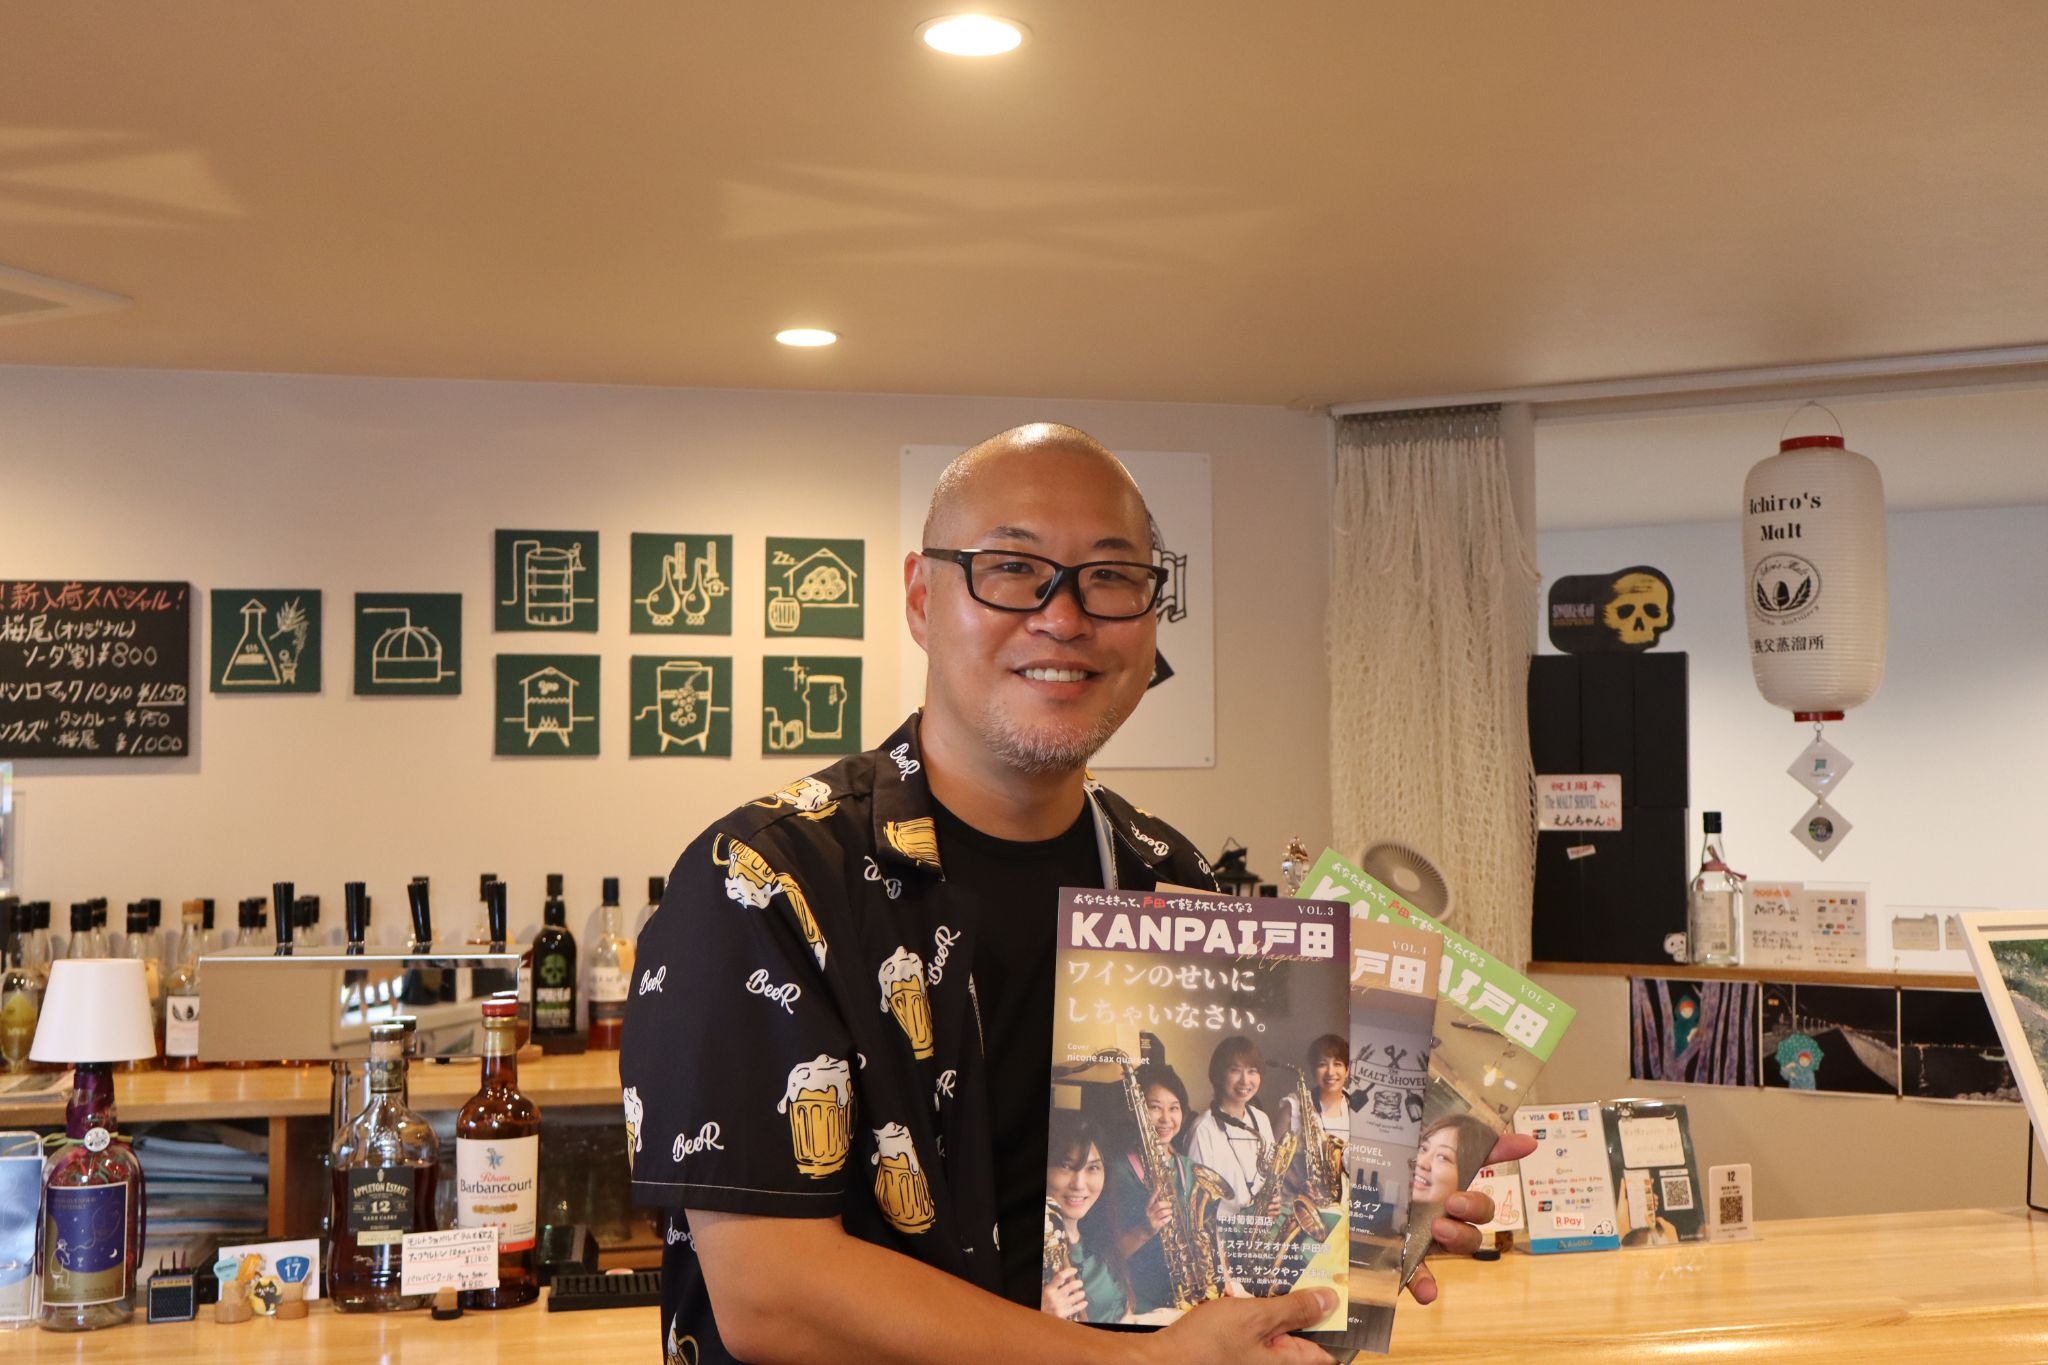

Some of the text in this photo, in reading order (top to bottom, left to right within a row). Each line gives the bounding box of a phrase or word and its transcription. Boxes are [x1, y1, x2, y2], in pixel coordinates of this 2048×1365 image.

[1750, 492, 1821, 514] Ichiro's
[1760, 523, 1802, 541] Malt
[98, 641, 158, 668] ¥800
[1073, 893, 1253, 913] あなたもきっと、戸田で乾杯したくなる
[1298, 905, 1334, 916] VOL.3
[1071, 911, 1334, 959] KANPAI戸田
[639, 965, 667, 996] BeeR
[1068, 960, 1256, 992] ワインのせいに
[745, 968, 802, 1015] BeeR
[1068, 997, 1266, 1033] しちゃいなさい。
[1098, 1055, 1115, 1064] sax
[1358, 1066, 1427, 1087] MALT SHOVEL
[672, 1121, 725, 1162] BeeR
[460, 1178, 532, 1194] Barbancourt
[1727, 1171, 1736, 1182] 12
[371, 1200, 391, 1214] 12
[1564, 1216, 1582, 1226] Pay
[284, 1263, 301, 1277] 17
